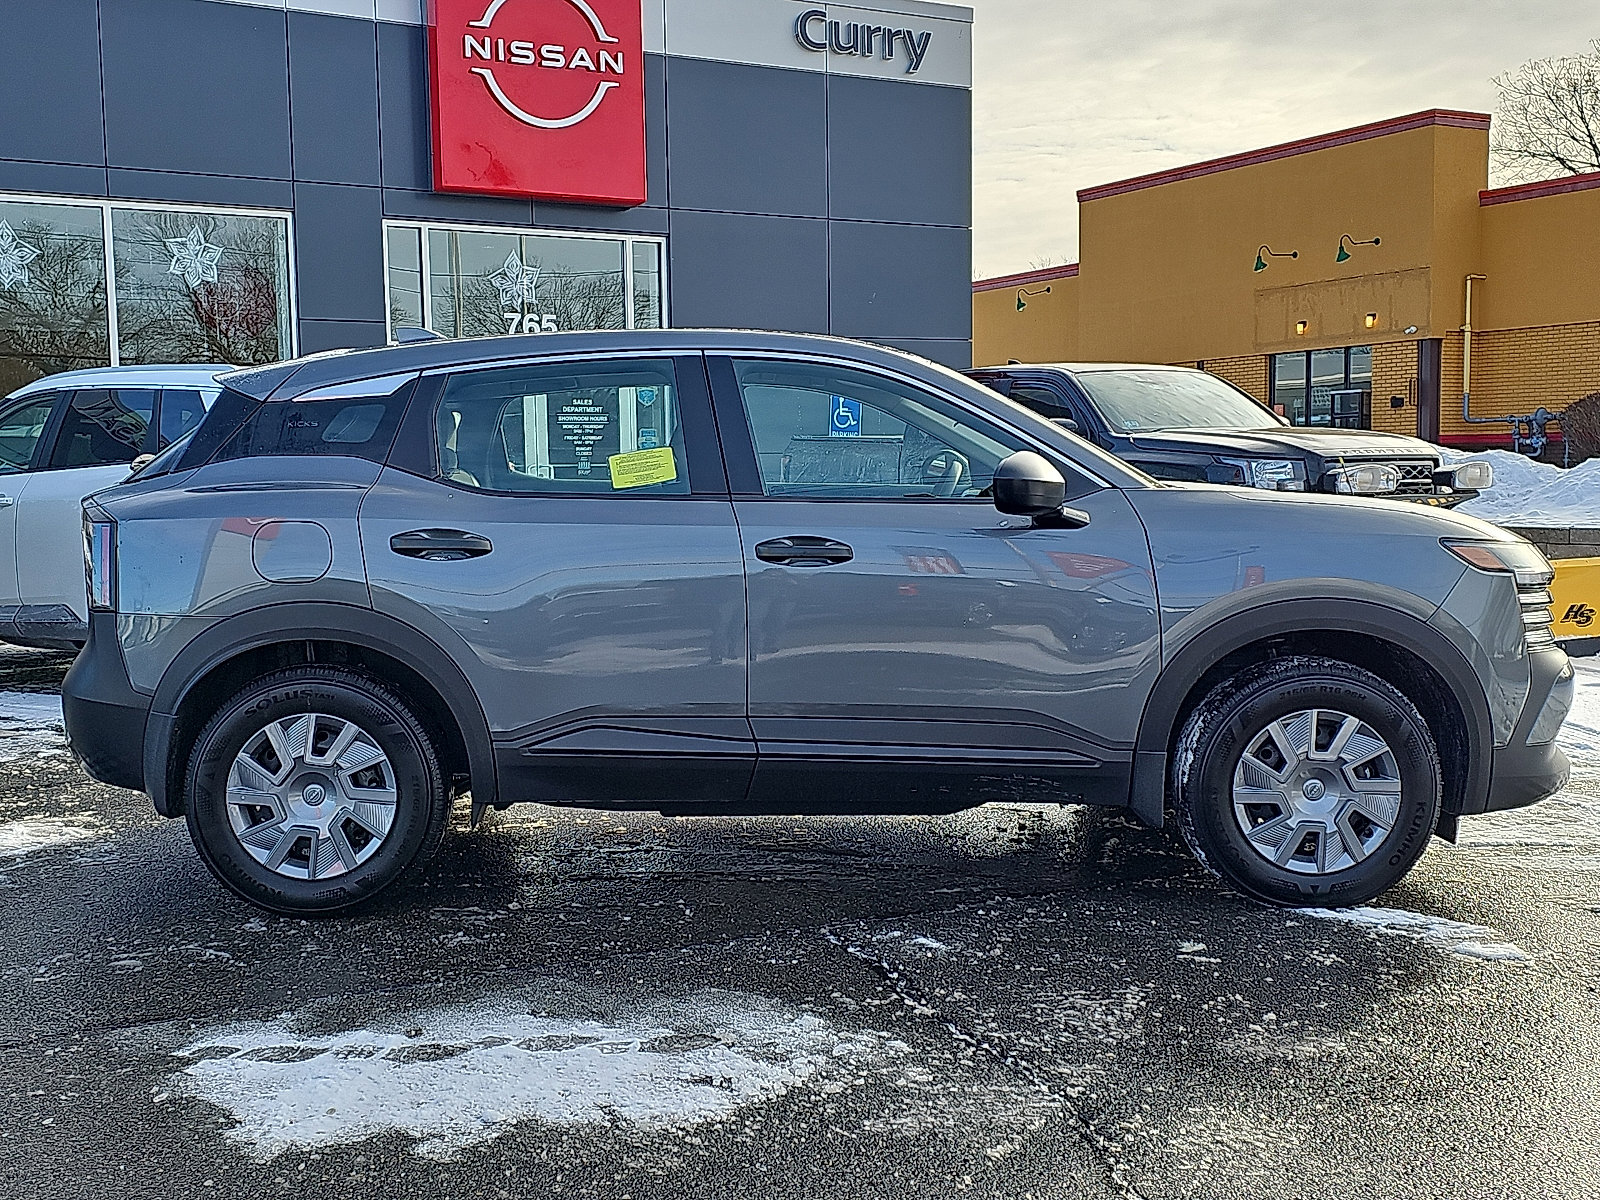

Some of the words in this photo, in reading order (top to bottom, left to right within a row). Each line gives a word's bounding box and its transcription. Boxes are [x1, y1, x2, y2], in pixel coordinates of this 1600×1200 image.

[462, 34, 624, 74] NISSAN
[795, 8, 933, 73] Curry
[503, 312, 558, 334] 765
[1560, 603, 1596, 627] HS
[243, 688, 313, 719] SOLUS
[1320, 685, 1342, 694] R16
[1388, 801, 1426, 867] KUMHO
